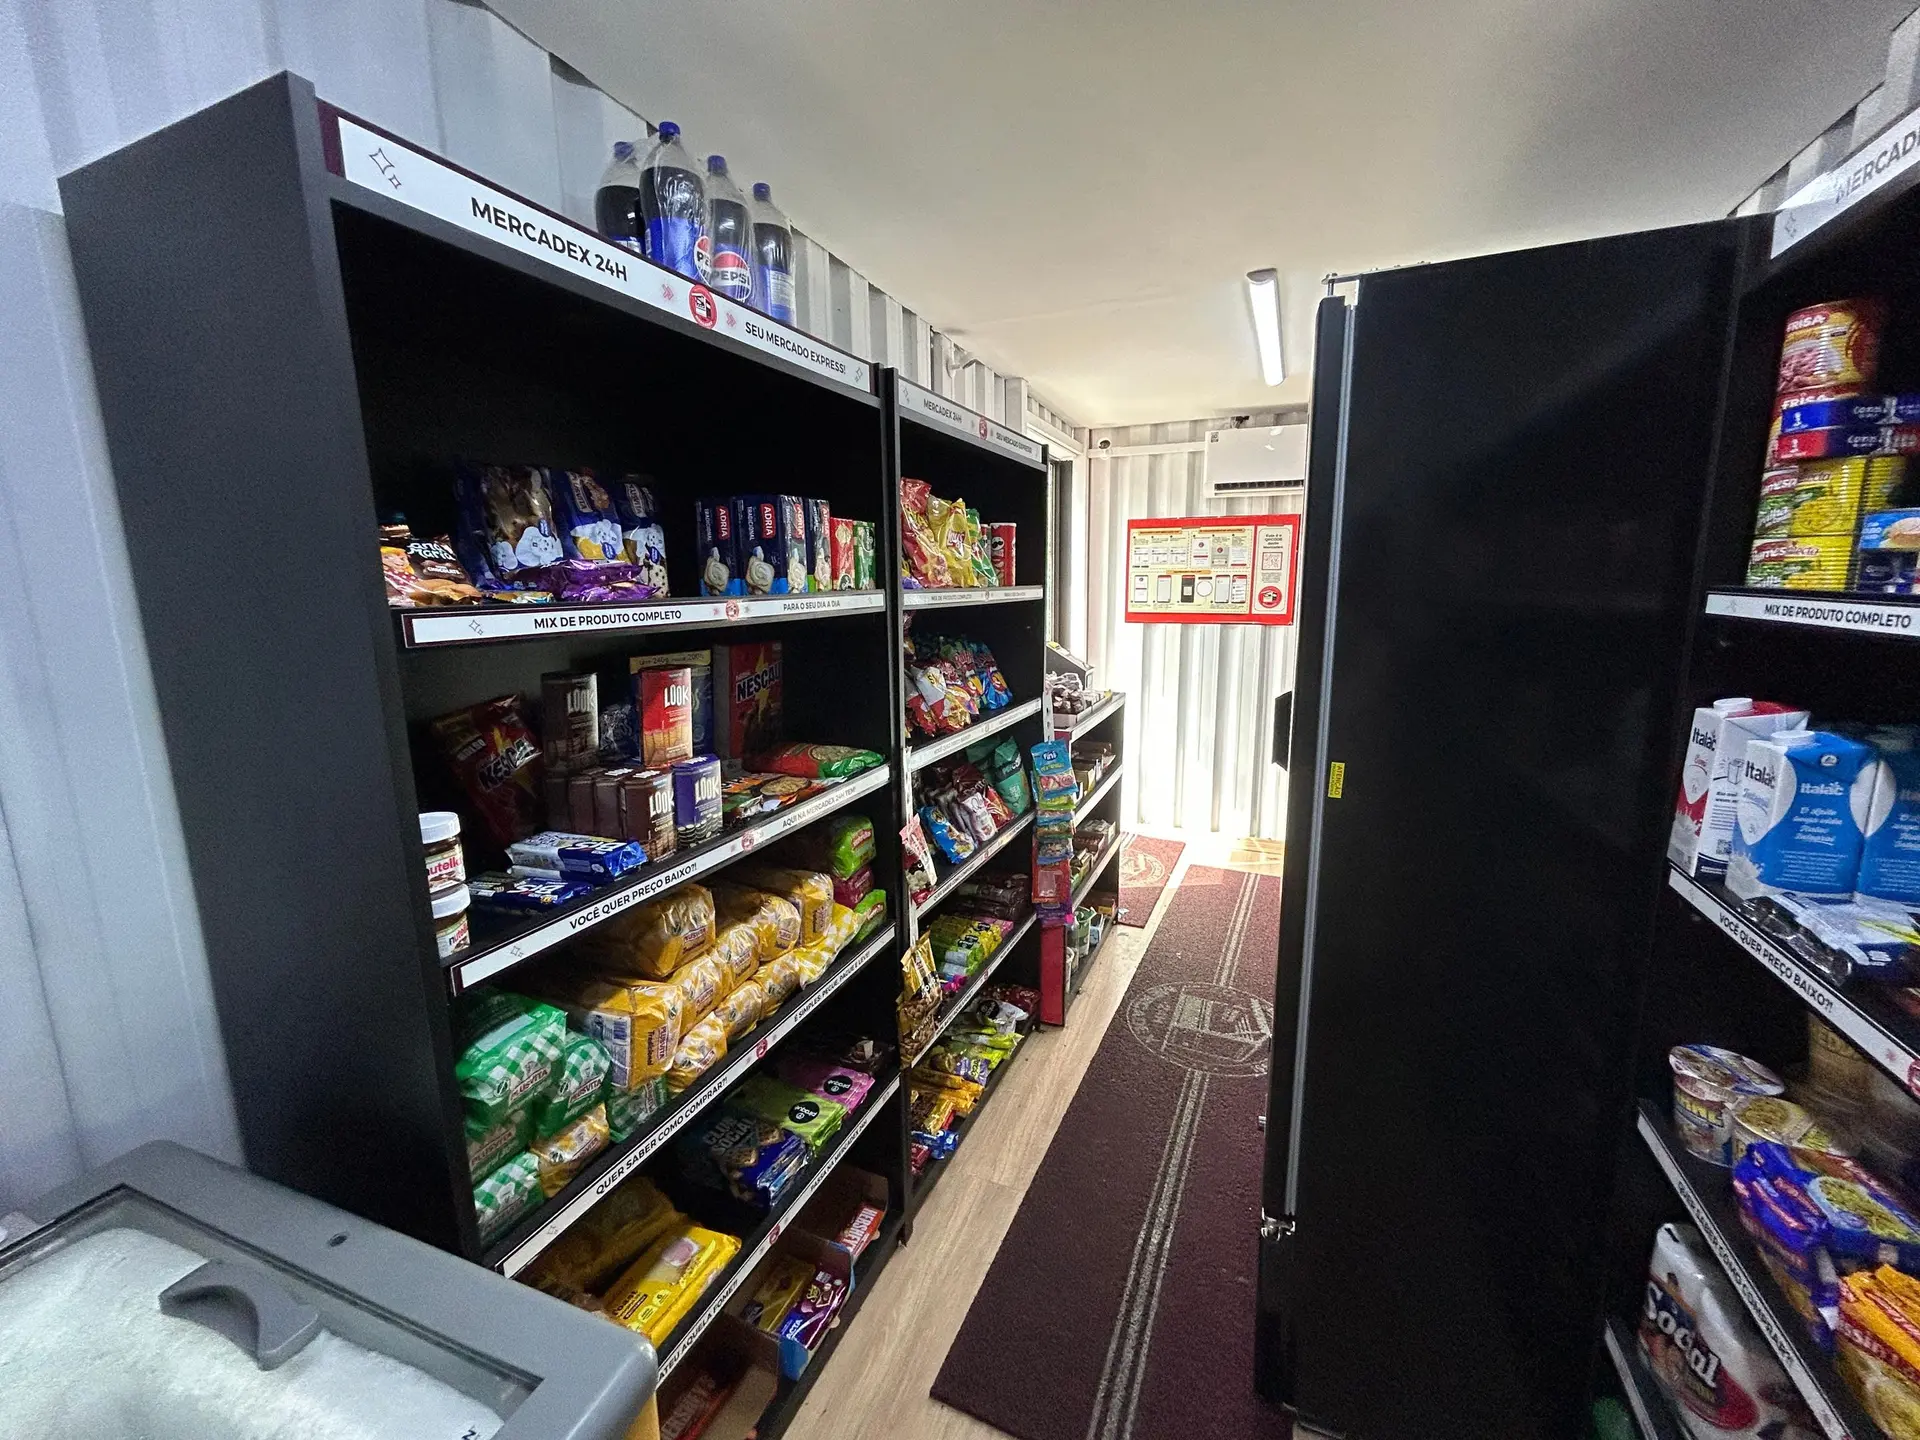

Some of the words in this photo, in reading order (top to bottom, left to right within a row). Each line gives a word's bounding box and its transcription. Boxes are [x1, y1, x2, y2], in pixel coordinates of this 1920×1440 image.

[1835, 127, 1920, 204] MERCAD
[471, 197, 592, 267] MERCADEX
[594, 253, 628, 282] 24H
[711, 270, 750, 285] PEPSI
[745, 321, 764, 340] SEU
[765, 331, 809, 359] MERCADO
[810, 351, 846, 375] EXPRESS!
[924, 398, 952, 419] MERCADEX
[719, 508, 728, 537] ADRIA
[763, 505, 774, 536] ADRIA
[534, 617, 558, 629] MIX
[560, 616, 576, 627] DE
[578, 613, 630, 626] PRODUTO
[632, 610, 682, 622] COMPLETO
[783, 602, 800, 612] PARA
[800, 602, 806, 610] O
[806, 601, 817, 609] SEU
[831, 600, 840, 608] DIA
[1765, 604, 1781, 616] MIX
[1782, 605, 1794, 617] DE
[1796, 607, 1844, 622] PRODUTO
[1845, 611, 1911, 629] COMPLETO
[567, 689, 596, 713] LOOK
[664, 685, 691, 708] LOOK
[650, 790, 675, 816] LOOK
[694, 775, 720, 803] LOOK
[569, 906, 600, 930] VOCÊ
[602, 894, 630, 915] QUER
[632, 880, 664, 901] PREÇO
[664, 862, 697, 885] BAIXO?!
[1719, 912, 1740, 935] VOCÊ
[1739, 927, 1762, 953] QUER
[1763, 947, 1793, 980] PREÇO
[1793, 972, 1834, 1013] BAIXO?!
[511, 1068, 549, 1100] PLUSVITA
[596, 1167, 625, 1195] QUER
[626, 1140, 657, 1169] SABER
[658, 1115, 684, 1142] COMO
[684, 1077, 728, 1118] COMPRAR?!
[678, 1313, 712, 1358] AQUELA
[713, 1279, 739, 1312] FOME?!
